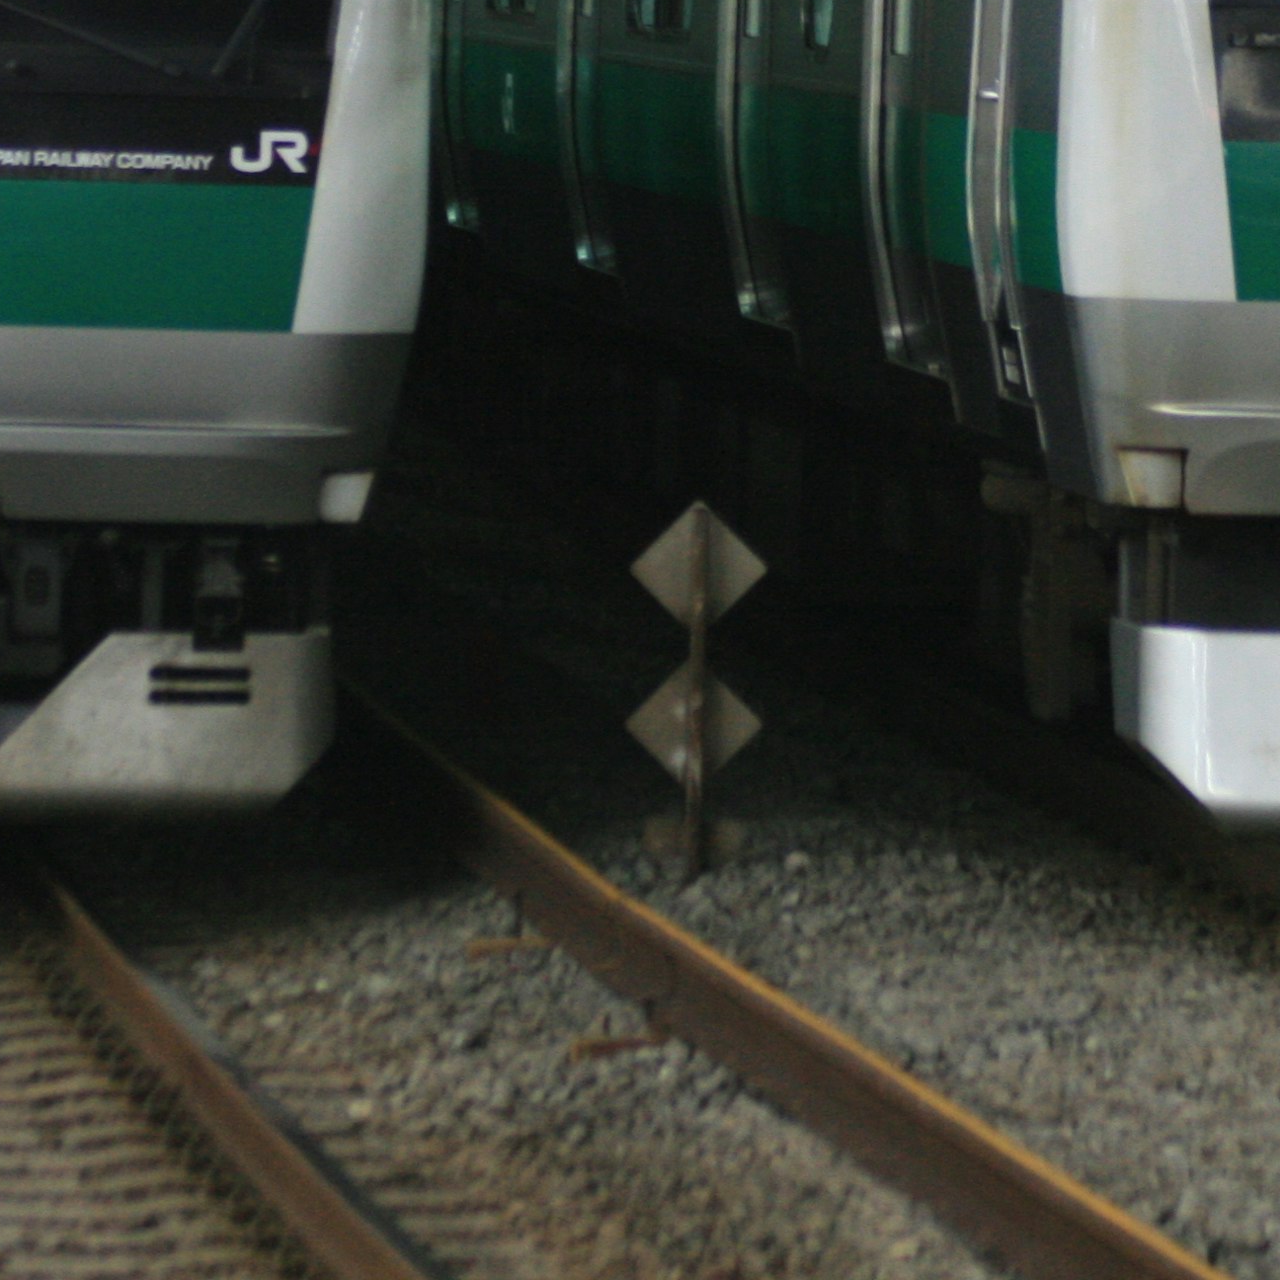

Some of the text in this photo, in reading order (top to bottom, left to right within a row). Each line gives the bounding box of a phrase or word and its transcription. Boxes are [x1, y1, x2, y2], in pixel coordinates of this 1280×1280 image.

[32, 150, 114, 169] RAILWAY
[116, 152, 214, 171] COMPANY
[229, 129, 309, 174] JR
